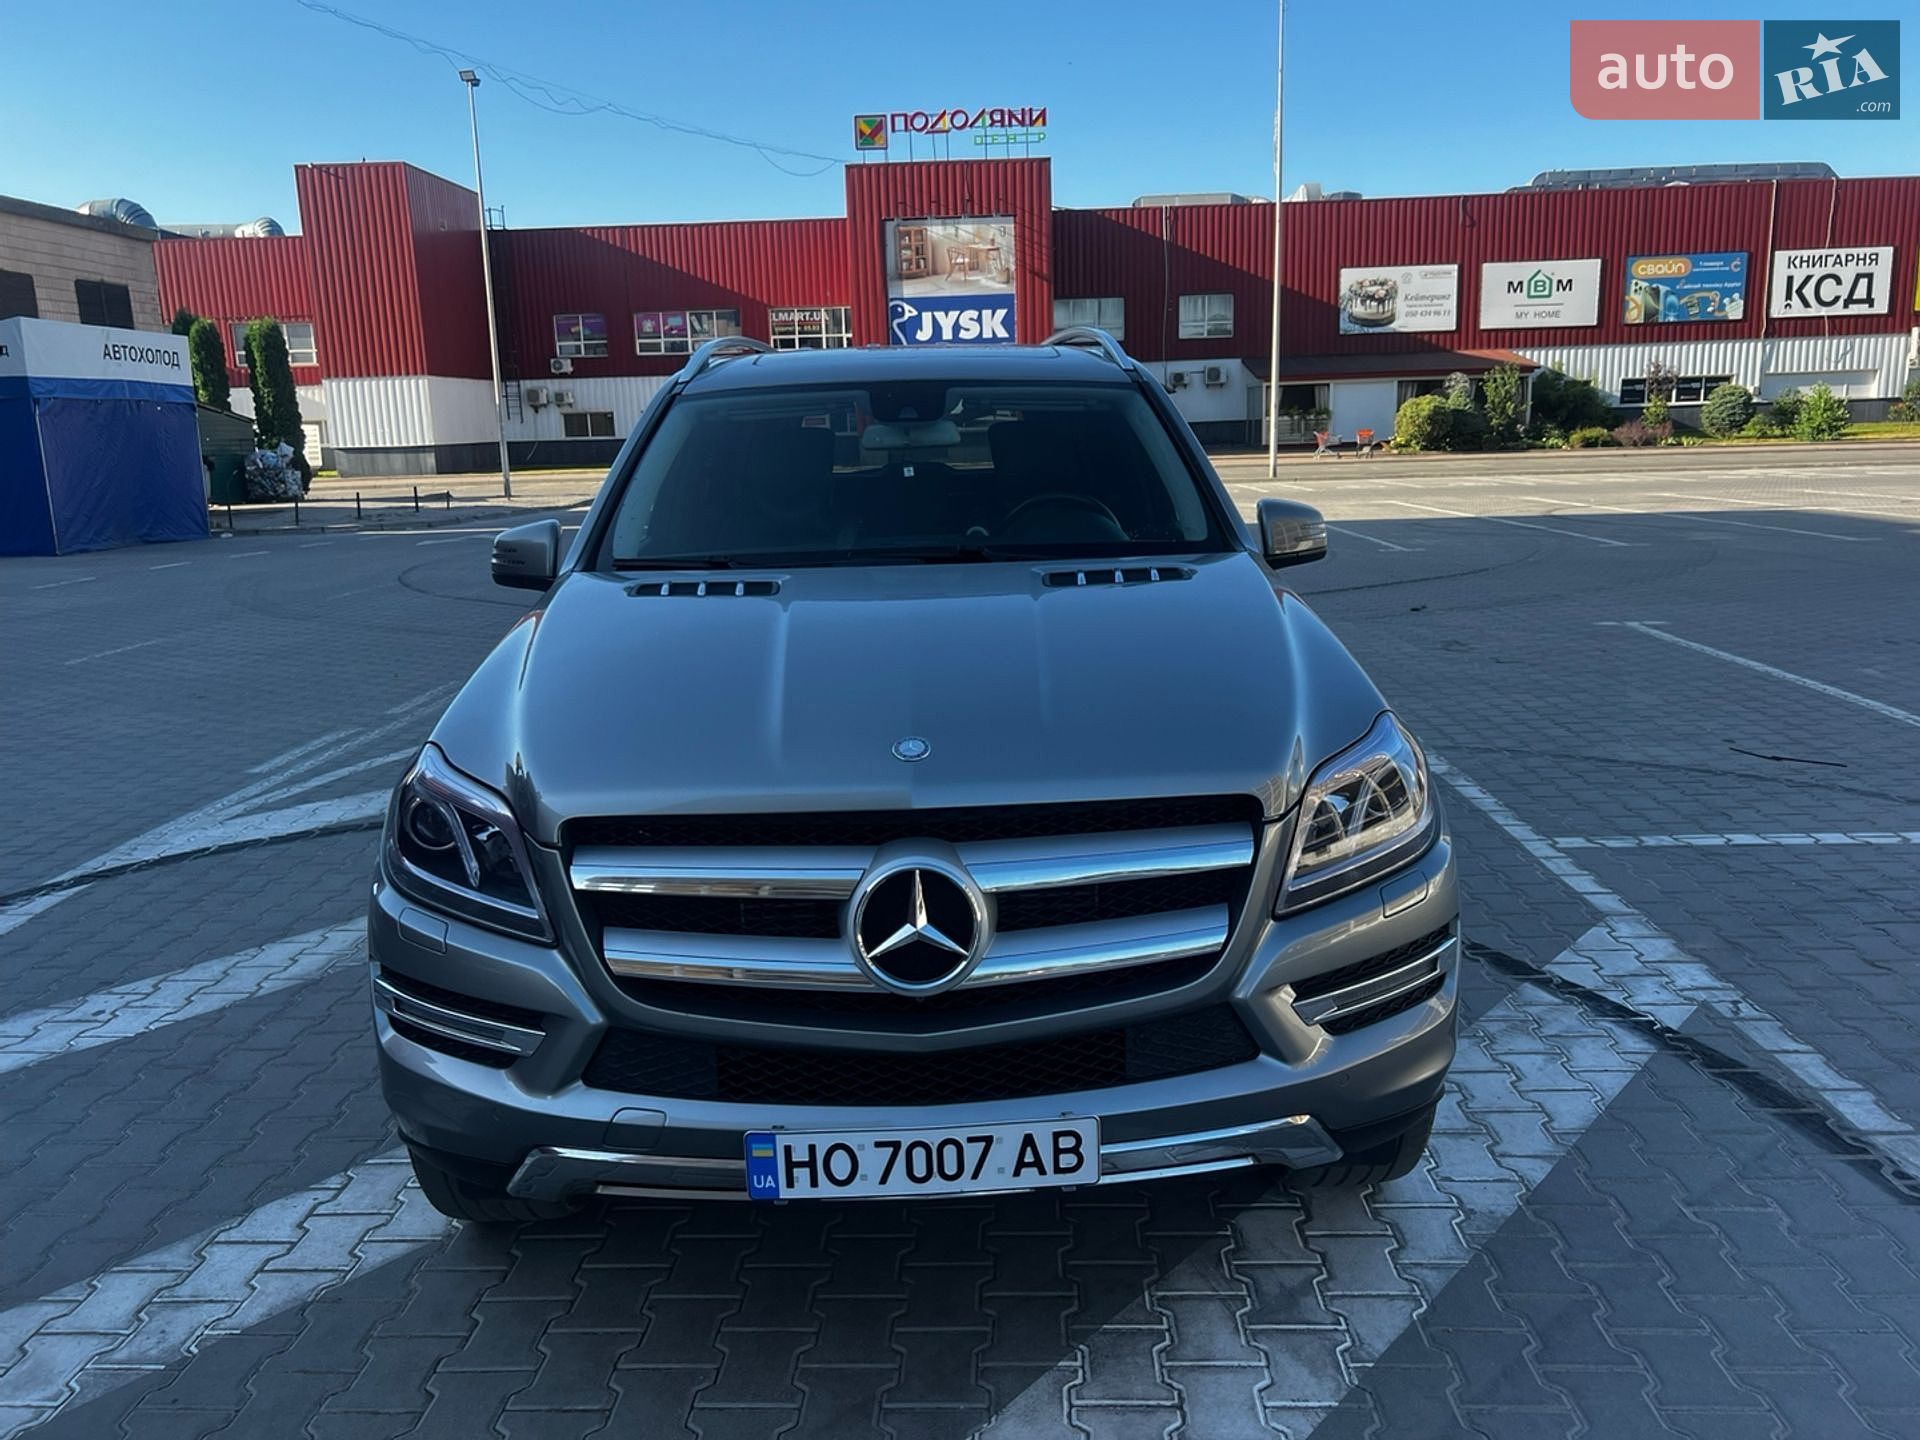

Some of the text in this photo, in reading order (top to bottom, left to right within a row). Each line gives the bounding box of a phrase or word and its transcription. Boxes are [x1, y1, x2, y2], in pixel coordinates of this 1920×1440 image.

[1787, 252, 1879, 269] КНИГАРНЯ
[1784, 272, 1875, 309] КСД
[915, 309, 1010, 341] JYSK
[1534, 310, 1561, 319] HOME
[103, 343, 181, 370] АВТОХОЛОД
[783, 1130, 1085, 1189] HO 7007 AB
[753, 1174, 776, 1190] UA
